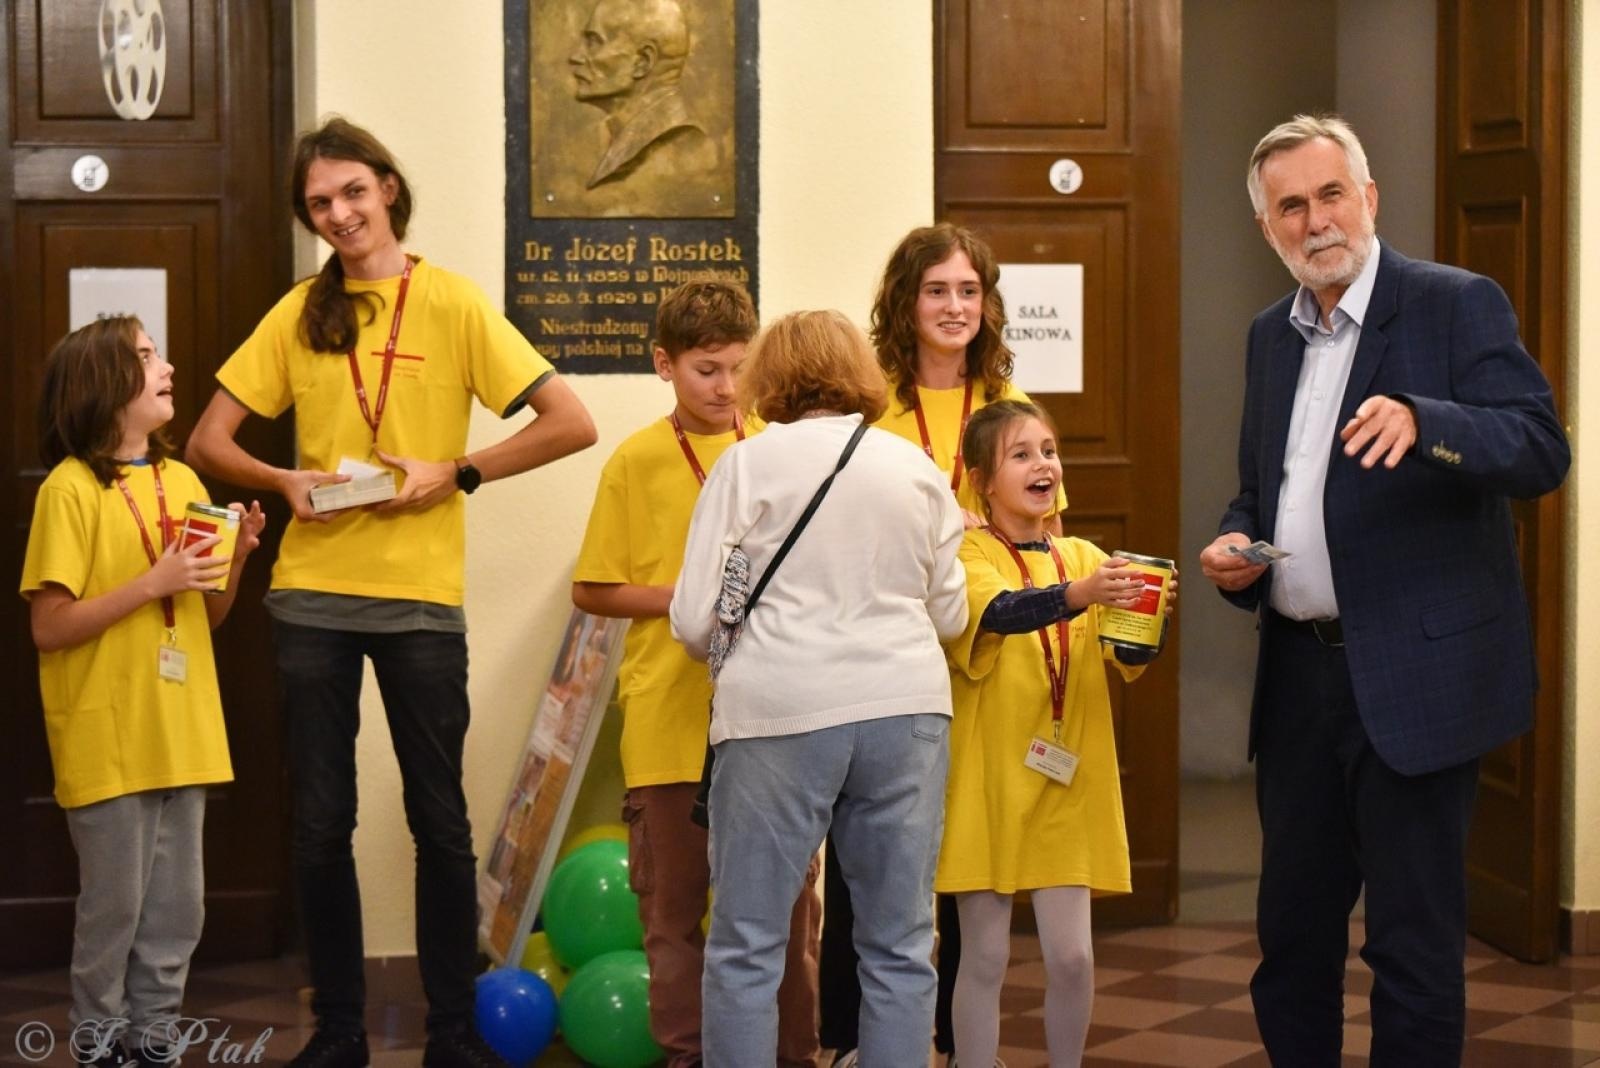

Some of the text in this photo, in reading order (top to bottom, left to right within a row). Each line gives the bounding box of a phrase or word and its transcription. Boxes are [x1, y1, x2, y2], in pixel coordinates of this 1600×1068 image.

[565, 238, 637, 264] Józef
[650, 237, 742, 261] Rostek
[1018, 305, 1058, 319] SALA
[540, 318, 649, 338] Niestrudzony
[1005, 327, 1072, 341] KINOWA
[564, 339, 622, 358] polskiej
[625, 344, 644, 355] na
